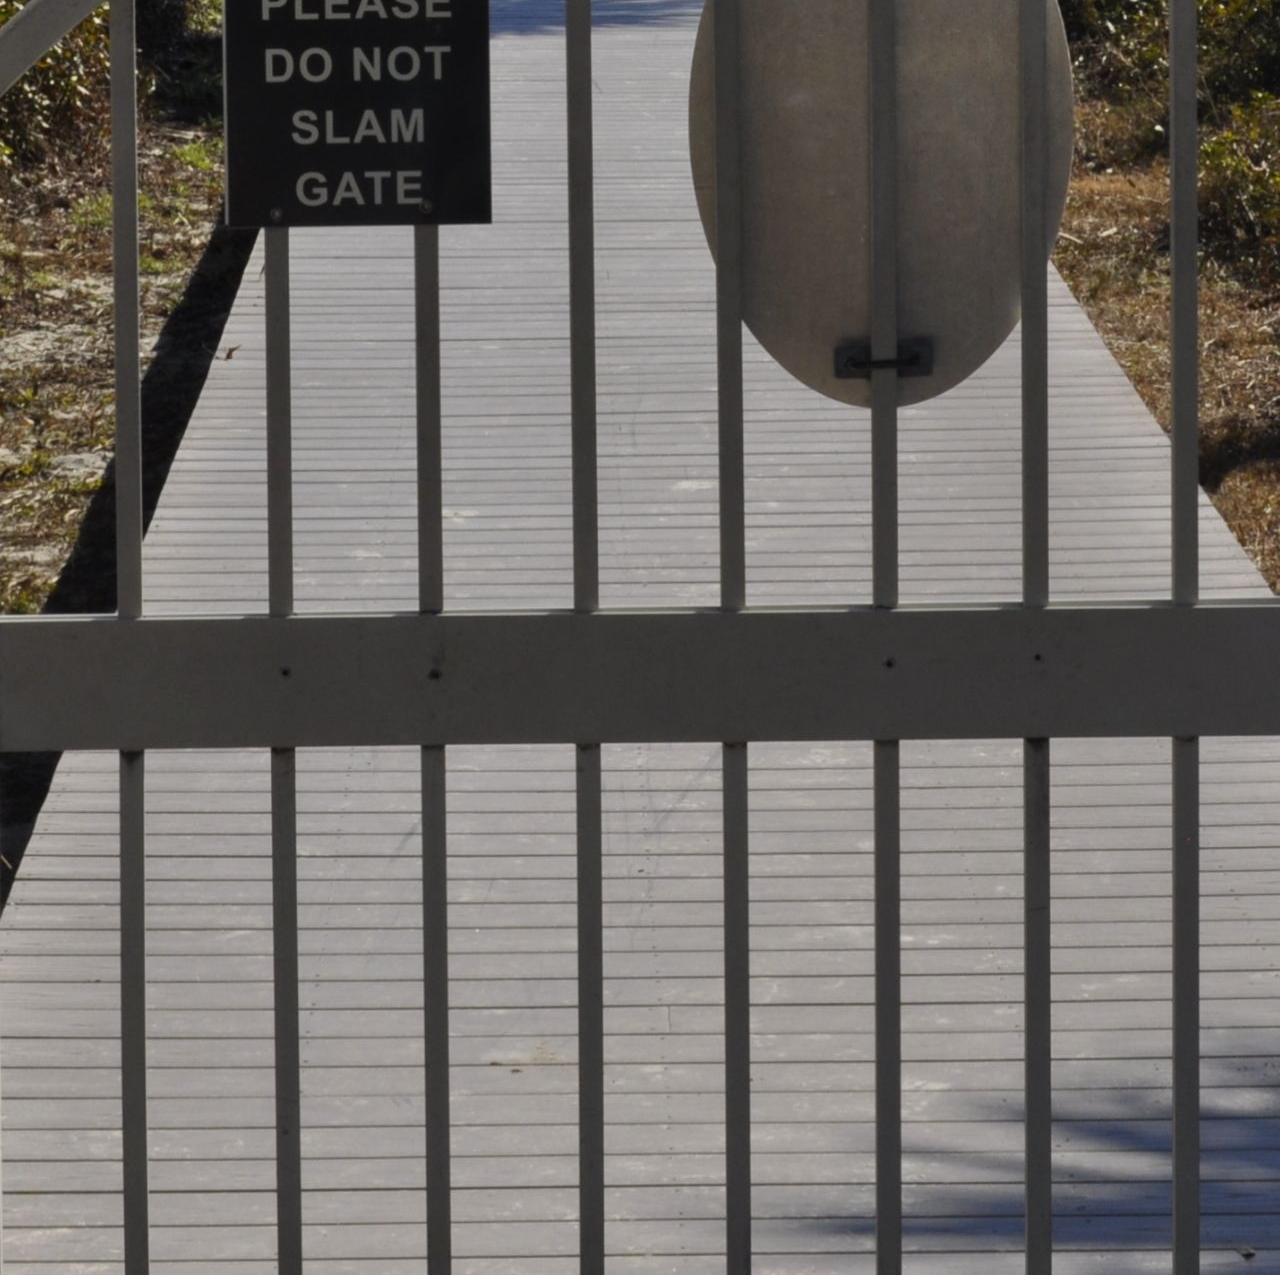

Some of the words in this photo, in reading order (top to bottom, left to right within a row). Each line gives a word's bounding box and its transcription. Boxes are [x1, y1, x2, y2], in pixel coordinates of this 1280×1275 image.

[265, 47, 333, 83] DO
[353, 46, 452, 81] NOT
[291, 108, 425, 145] SLAM
[295, 170, 423, 206] GATE
